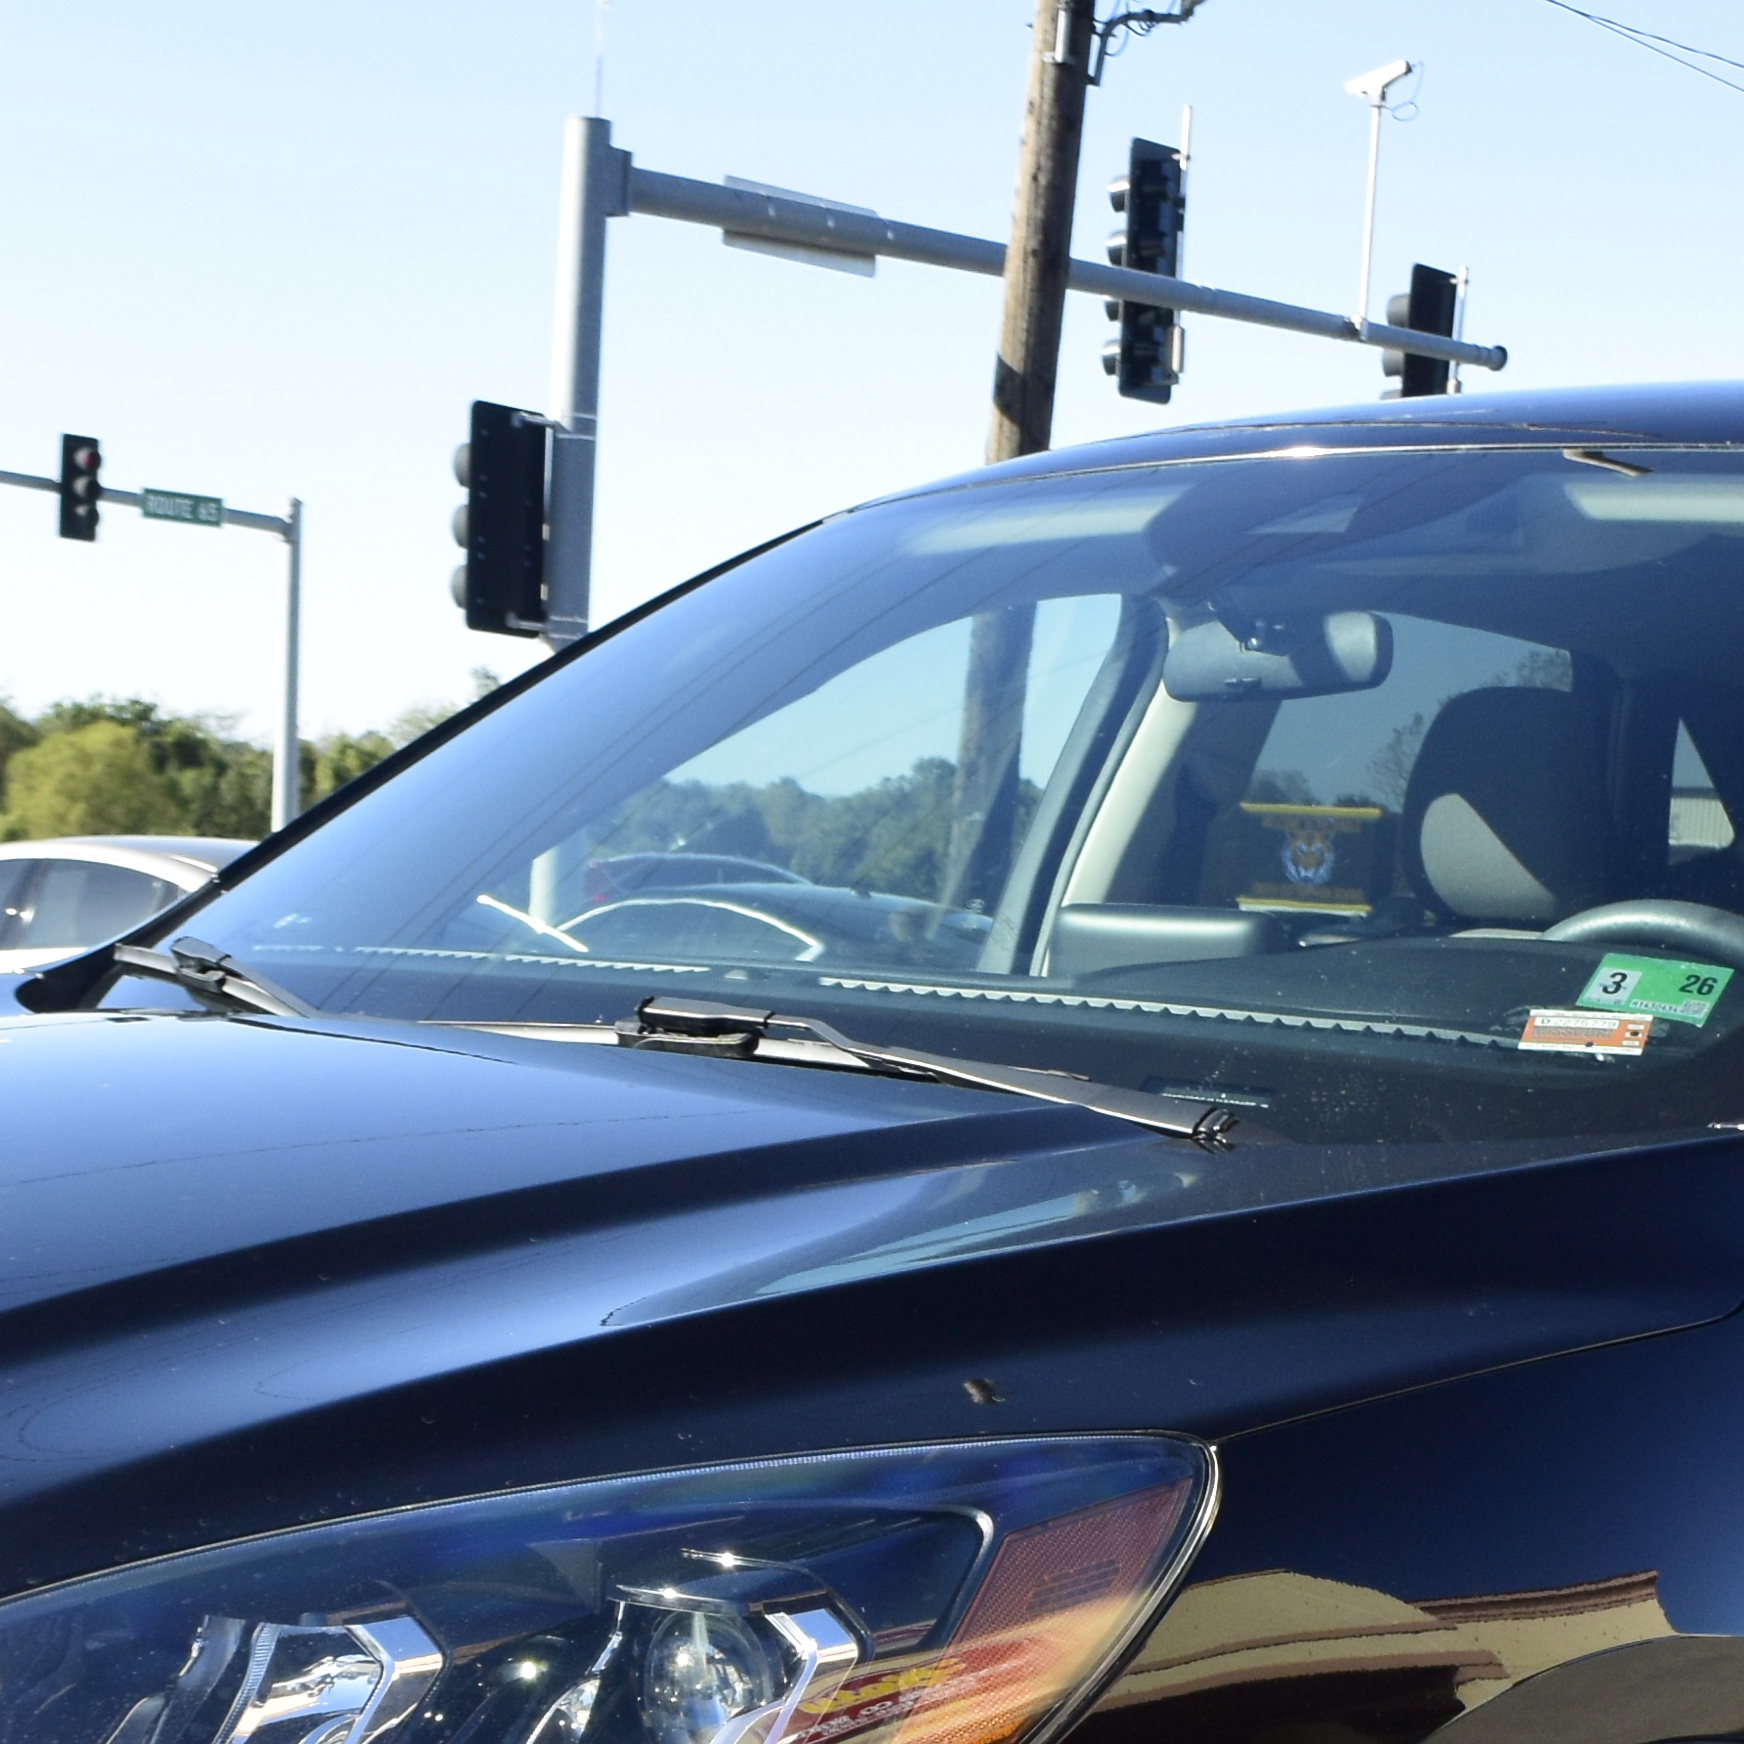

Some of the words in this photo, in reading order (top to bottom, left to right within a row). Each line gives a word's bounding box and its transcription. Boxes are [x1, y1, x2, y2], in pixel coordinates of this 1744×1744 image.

[146, 494, 194, 519] ROUTE
[1602, 972, 1628, 995] 3
[1679, 974, 1718, 996] 26
